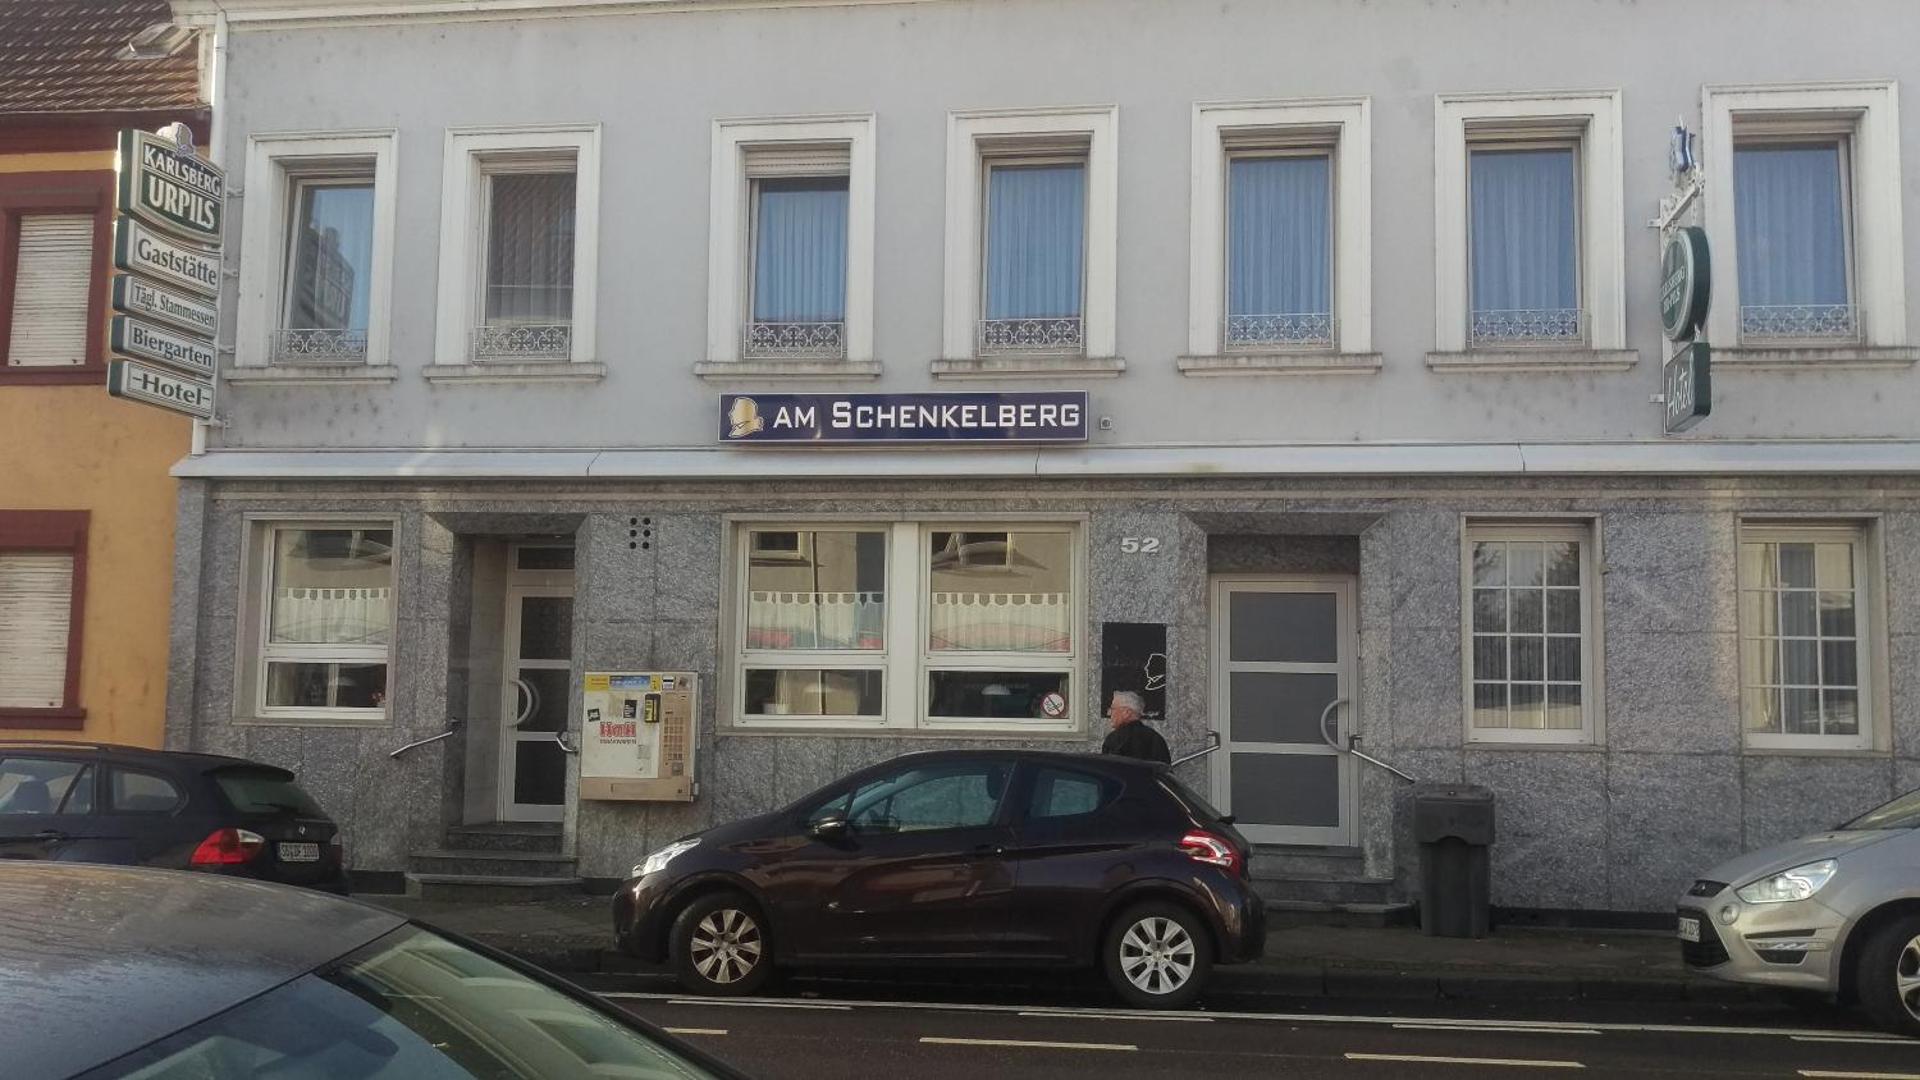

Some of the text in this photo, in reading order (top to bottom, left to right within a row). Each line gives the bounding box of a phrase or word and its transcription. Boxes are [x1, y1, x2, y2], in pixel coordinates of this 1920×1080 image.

[144, 144, 221, 196] KARLSBERG
[149, 175, 215, 229] URPILS
[138, 238, 217, 286] Gaststätte
[160, 294, 215, 328] Stammessen
[133, 327, 212, 367] Biergarten
[1667, 351, 1694, 428] Hotel
[772, 406, 816, 429] AM
[1121, 537, 1160, 553] 52
